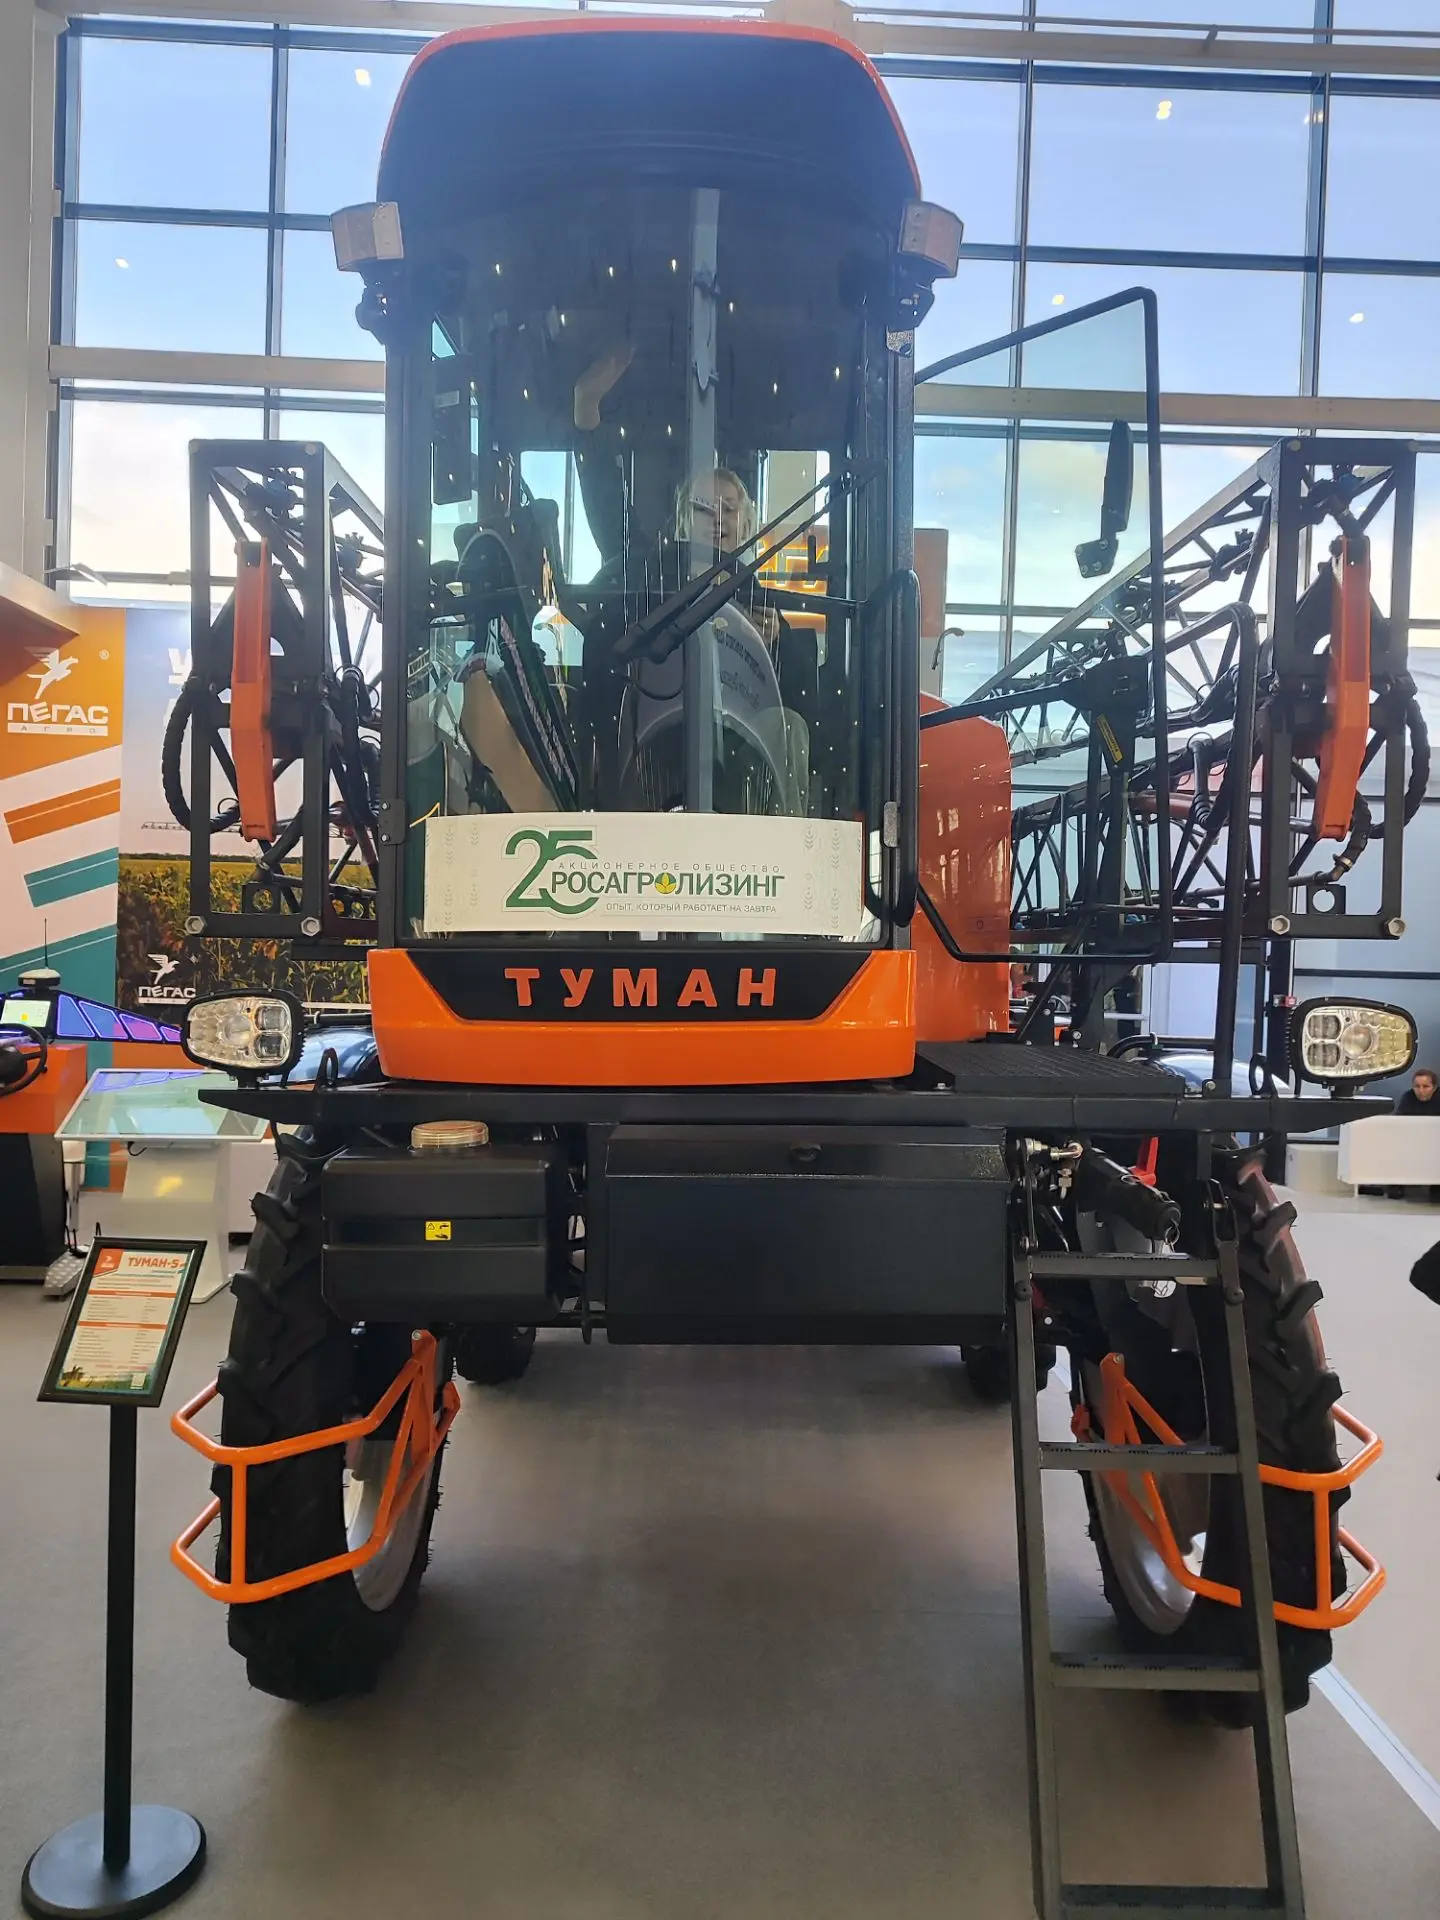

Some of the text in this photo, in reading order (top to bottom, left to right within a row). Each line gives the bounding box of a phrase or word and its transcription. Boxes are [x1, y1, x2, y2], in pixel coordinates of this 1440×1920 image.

[8, 702, 109, 724] ПЕГАС
[505, 829, 600, 915] 25
[558, 862, 780, 873] АКЦИОНЕРНОЕ ОБЩЕСТВО
[551, 871, 785, 897] РОСАГРОЛИЗИНГ
[637, 902, 681, 912] КОТОРЫЙ
[683, 903, 727, 913] РАБОТАЕТ
[744, 904, 776, 914] ЗАВТРА
[138, 985, 196, 998] ПЕГАС
[504, 967, 776, 1008] ТУМАН
